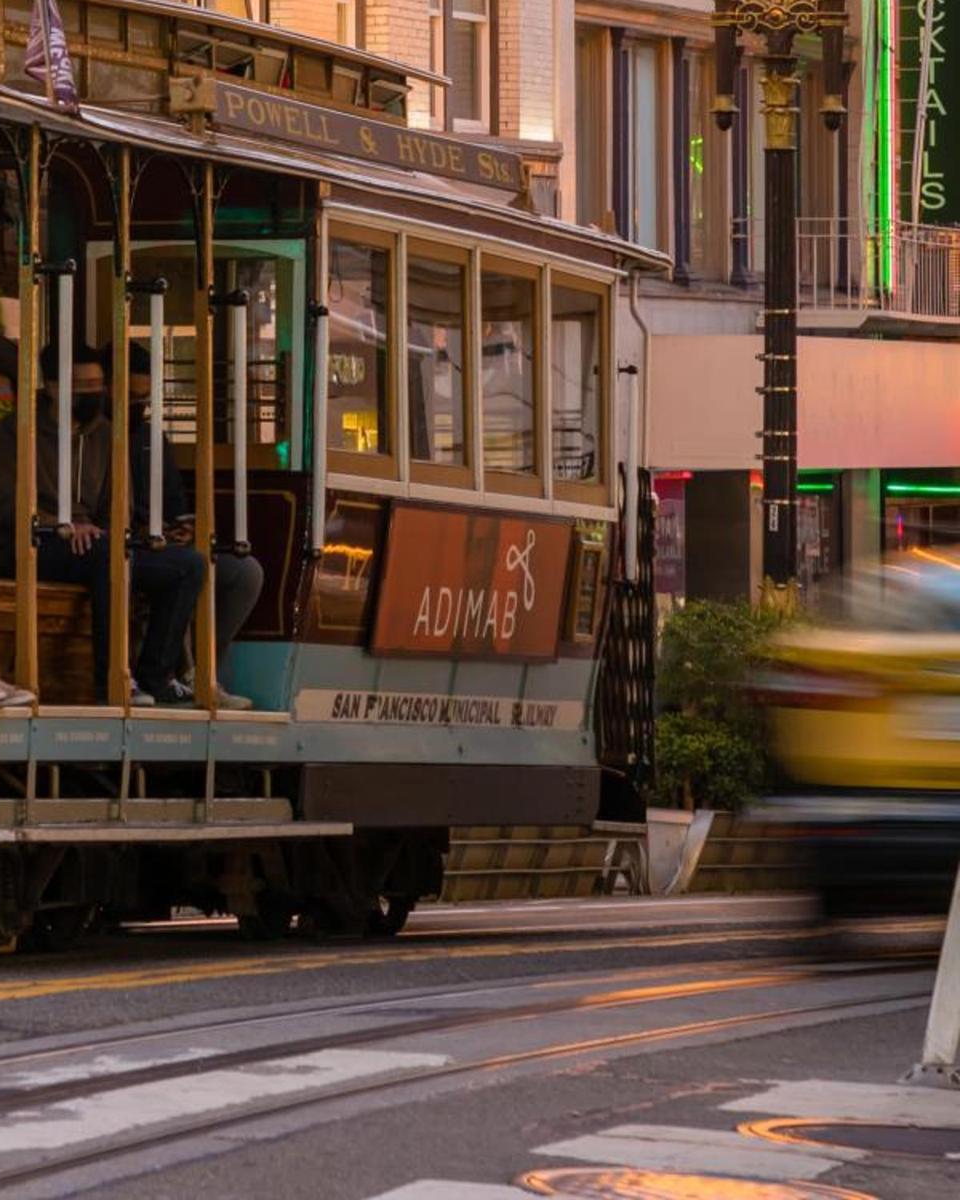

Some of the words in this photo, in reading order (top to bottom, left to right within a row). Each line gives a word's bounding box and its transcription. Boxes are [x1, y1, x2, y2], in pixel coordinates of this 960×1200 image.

[224, 91, 339, 144] POWELL
[359, 126, 378, 156] &
[396, 134, 465, 173] HYDE
[413, 586, 517, 639] ADIMAB
[332, 693, 361, 719] SAN
